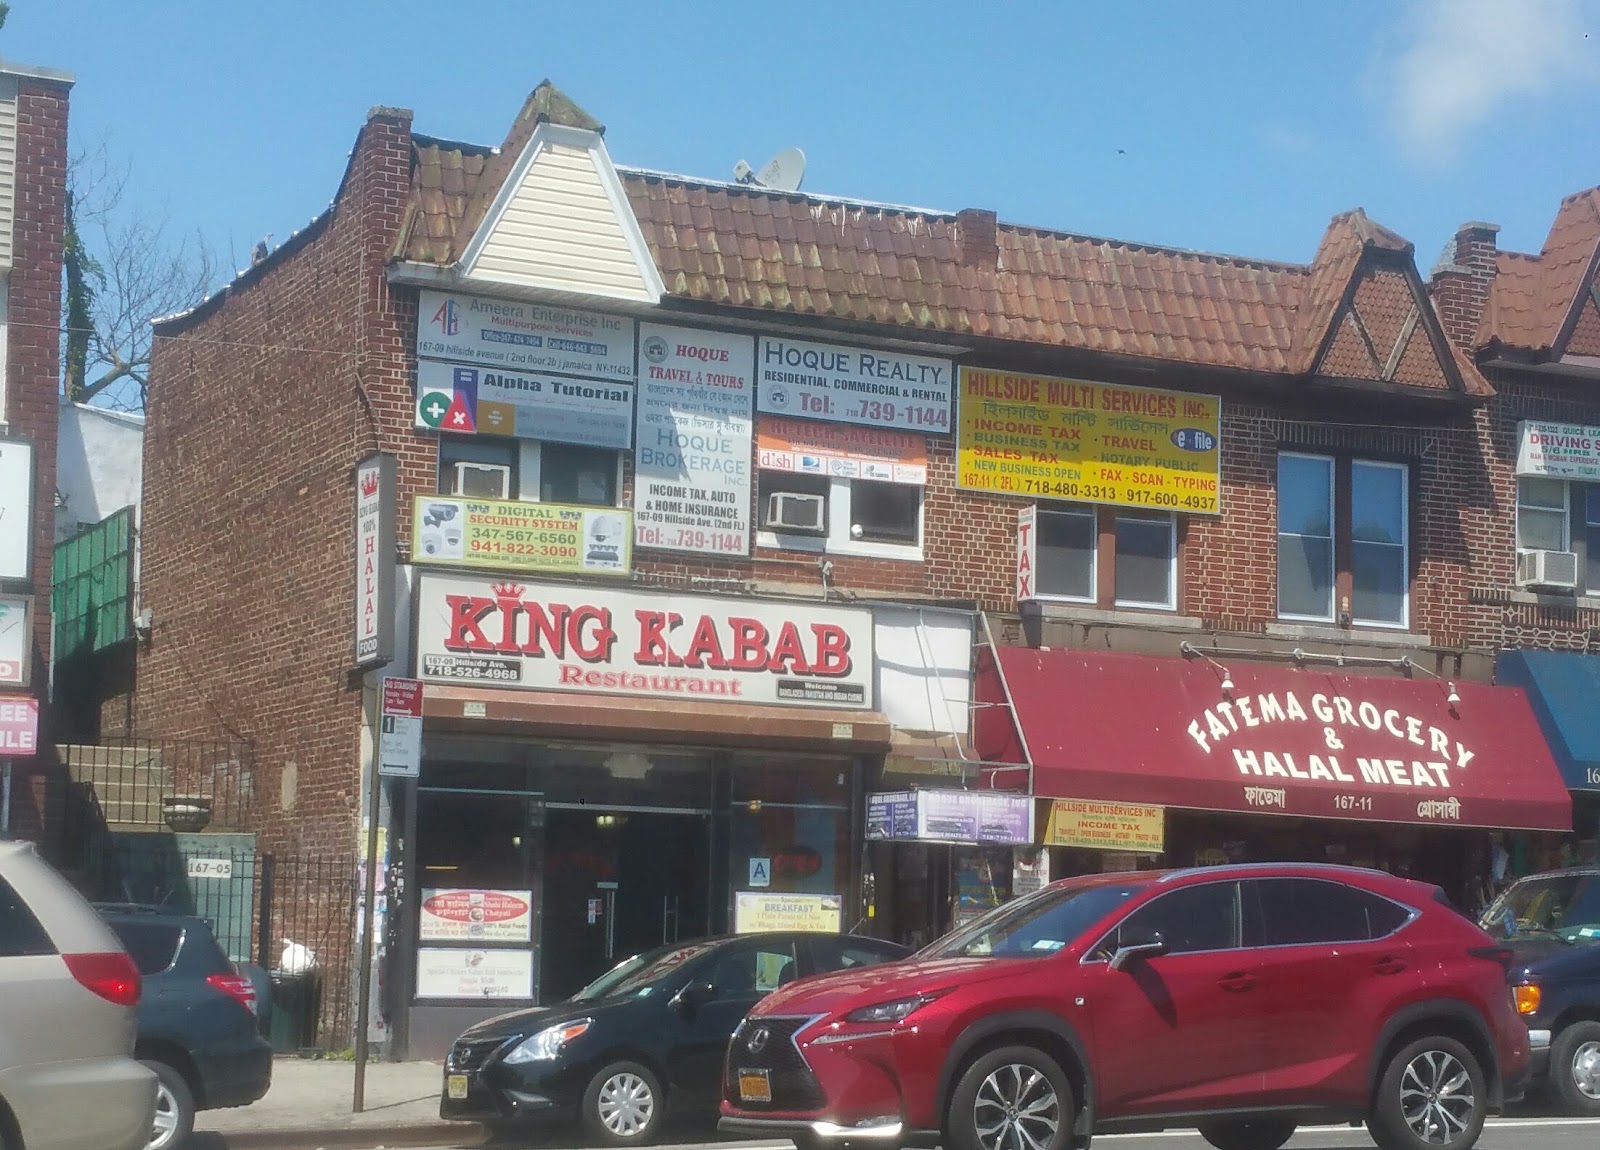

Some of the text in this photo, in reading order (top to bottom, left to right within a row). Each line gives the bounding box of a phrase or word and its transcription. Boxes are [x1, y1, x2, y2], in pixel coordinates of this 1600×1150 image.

[470, 299, 621, 330] Ameera Enterprise Inc
[491, 315, 593, 337] Multipurpose Services
[419, 342, 444, 354] 167-09
[446, 345, 474, 357] hillside
[476, 350, 504, 360] avenue
[511, 352, 525, 362] 2nd
[527, 355, 545, 365] floor
[562, 360, 592, 371] jamaica
[595, 364, 631, 375] NY-11432
[676, 344, 729, 362] HOQUE
[765, 341, 943, 385] HOQUE REALTY
[649, 366, 692, 384] TRAVEL
[706, 373, 744, 389] TOURS
[764, 370, 947, 403] RESIDENTIAL, COMMERCIAL & RENTAL
[484, 374, 541, 392] Alpha
[551, 382, 628, 402] Tutorial
[968, 372, 1040, 402] HILLSIDE
[1047, 382, 1094, 409] MULTI
[1102, 389, 1176, 419] SERVICES
[799, 392, 835, 415] Tel:
[859, 399, 948, 427] 739-1144
[974, 418, 1081, 440] INCOME TAX
[657, 428, 733, 453] HOQUE
[974, 432, 1080, 452] BUSINESS TAX
[1102, 435, 1157, 452] TRAVEL
[1530, 433, 1591, 450] DRIVING
[641, 447, 745, 475] BROKERAGE
[974, 444, 1058, 464] SALES TAX
[1101, 452, 1199, 472] NOTARY PUBLIC
[974, 459, 1081, 480] NEW BUSINESS OPEN
[1100, 468, 1216, 491] FAX SCAN TYPING
[649, 484, 735, 503] INCOME TAX, AUTO
[964, 473, 990, 487] 167-11
[1025, 480, 1116, 500] 718-480-3313
[1127, 488, 1216, 510] 917-600-4937
[497, 505, 554, 518] DIGITAL
[646, 500, 738, 519] & HOME INSURANCE
[470, 514, 578, 531] SECURITY SYSTEM
[637, 512, 663, 523] 167-09
[664, 515, 695, 526] Hillside
[697, 518, 713, 528] Ave.
[472, 527, 577, 545] 347-567-6560
[637, 526, 664, 545] Tel:
[677, 529, 742, 552] 739-1144
[470, 540, 577, 558] 941-822-3090
[1019, 523, 1032, 598] TAX
[364, 535, 376, 635] HALAL
[443, 594, 853, 678] KING KABAB
[359, 638, 378, 655] FOOD
[427, 665, 518, 680] 718-526-4968
[456, 658, 487, 667] Hillside
[489, 660, 507, 669] Ave.
[559, 663, 743, 697] Restaurant
[804, 682, 838, 691] Welcome
[1187, 691, 1476, 769] FATEMA GROCERY
[1323, 726, 1344, 750] &
[1231, 749, 1451, 788] HALAL MEAT
[1056, 801, 1156, 817] HILLSIDE MULTISERVICES INC
[1333, 795, 1372, 811] 167-11
[1078, 821, 1140, 831] INCOME TAX
[189, 863, 231, 874] 167-05
[753, 862, 766, 879] A
[765, 903, 813, 913] BREAKFAST
